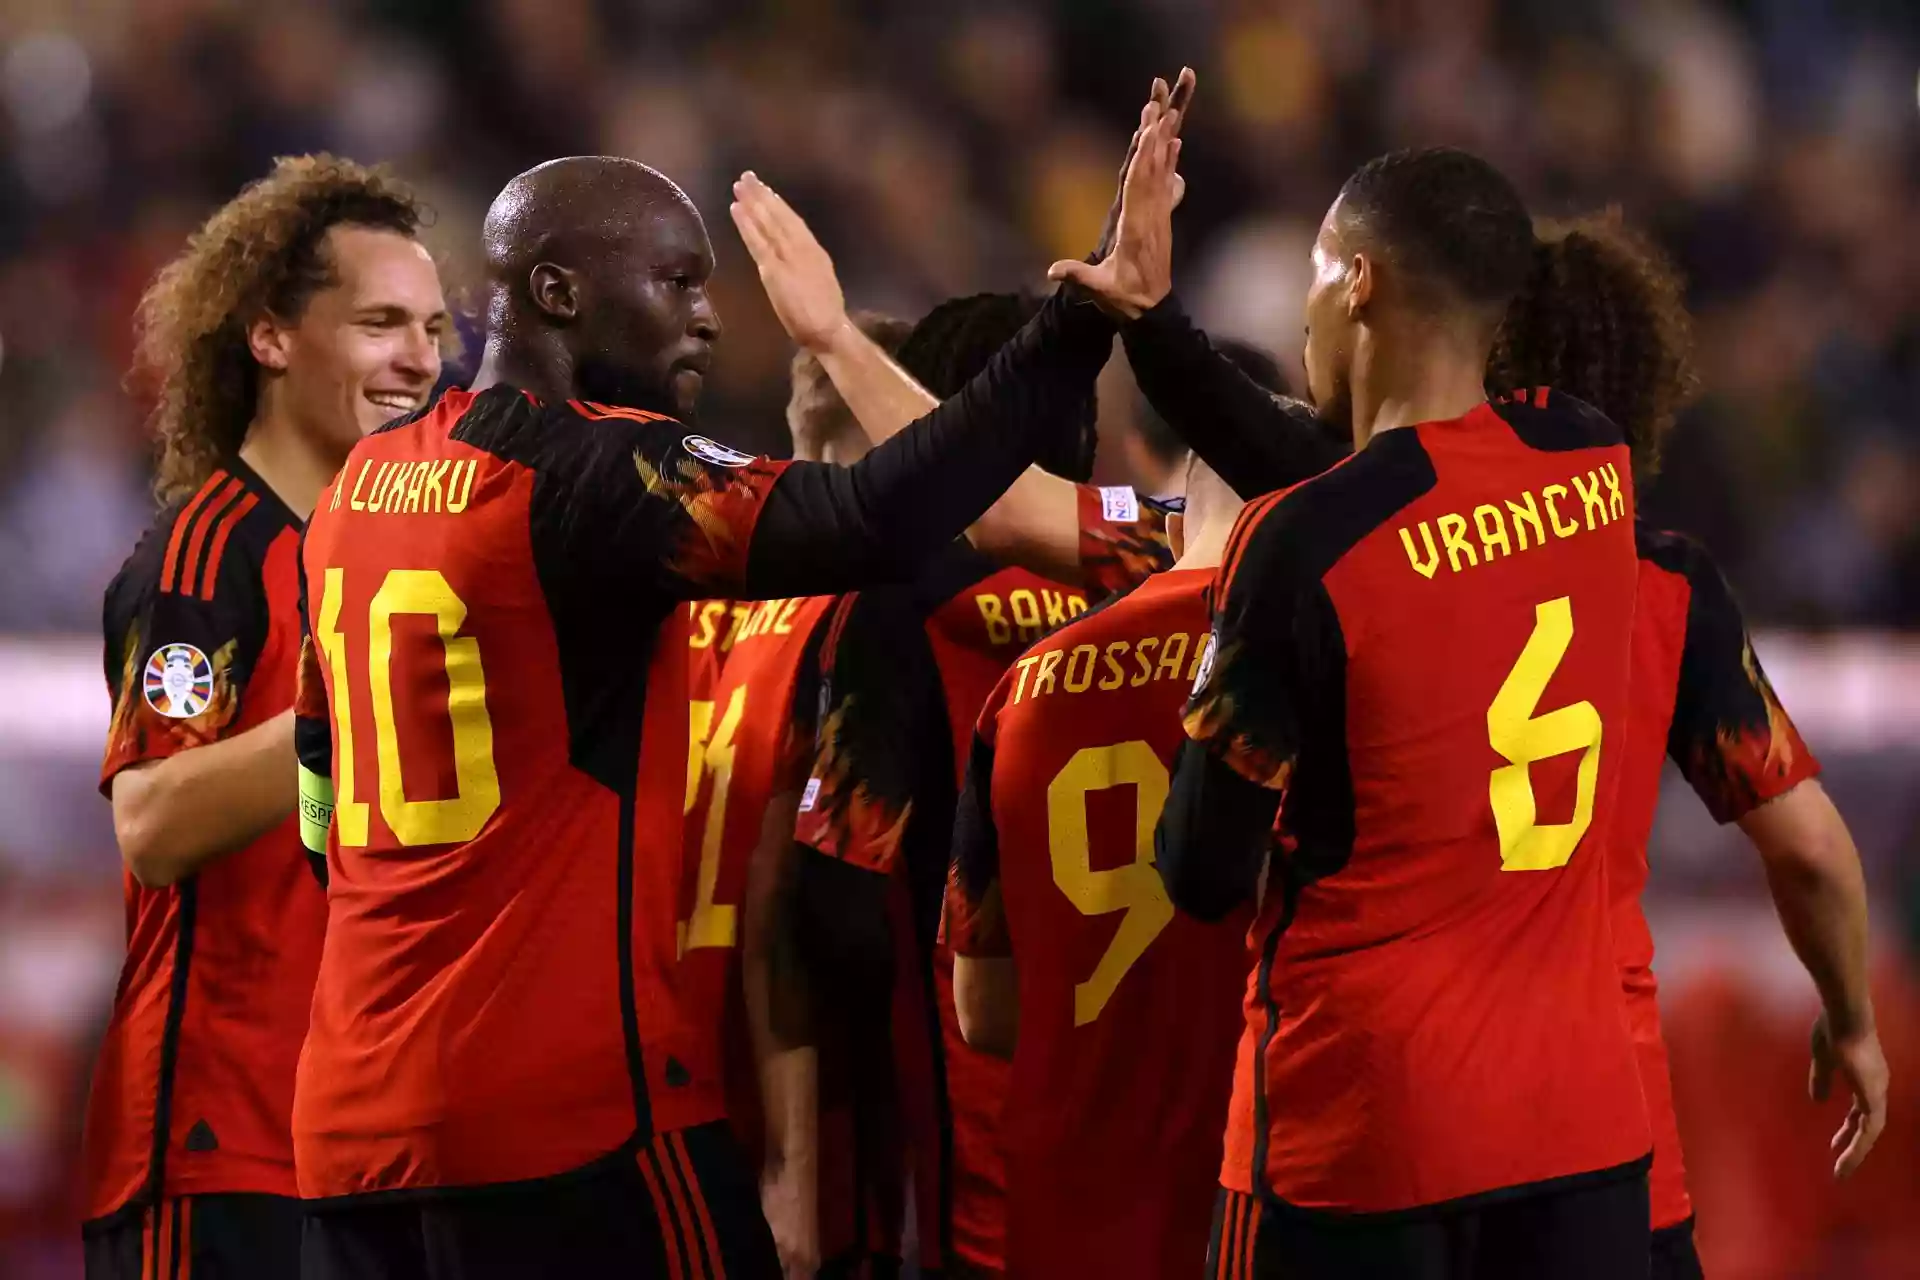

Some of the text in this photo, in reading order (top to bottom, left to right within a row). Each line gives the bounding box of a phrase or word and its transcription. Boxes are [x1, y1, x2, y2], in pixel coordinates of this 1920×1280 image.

[351, 459, 478, 514] LUKAKU
[1398, 462, 1625, 579] VRANCKX
[317, 567, 501, 847] 10
[1486, 595, 1603, 872] 6
[1047, 739, 1175, 1028] 9
